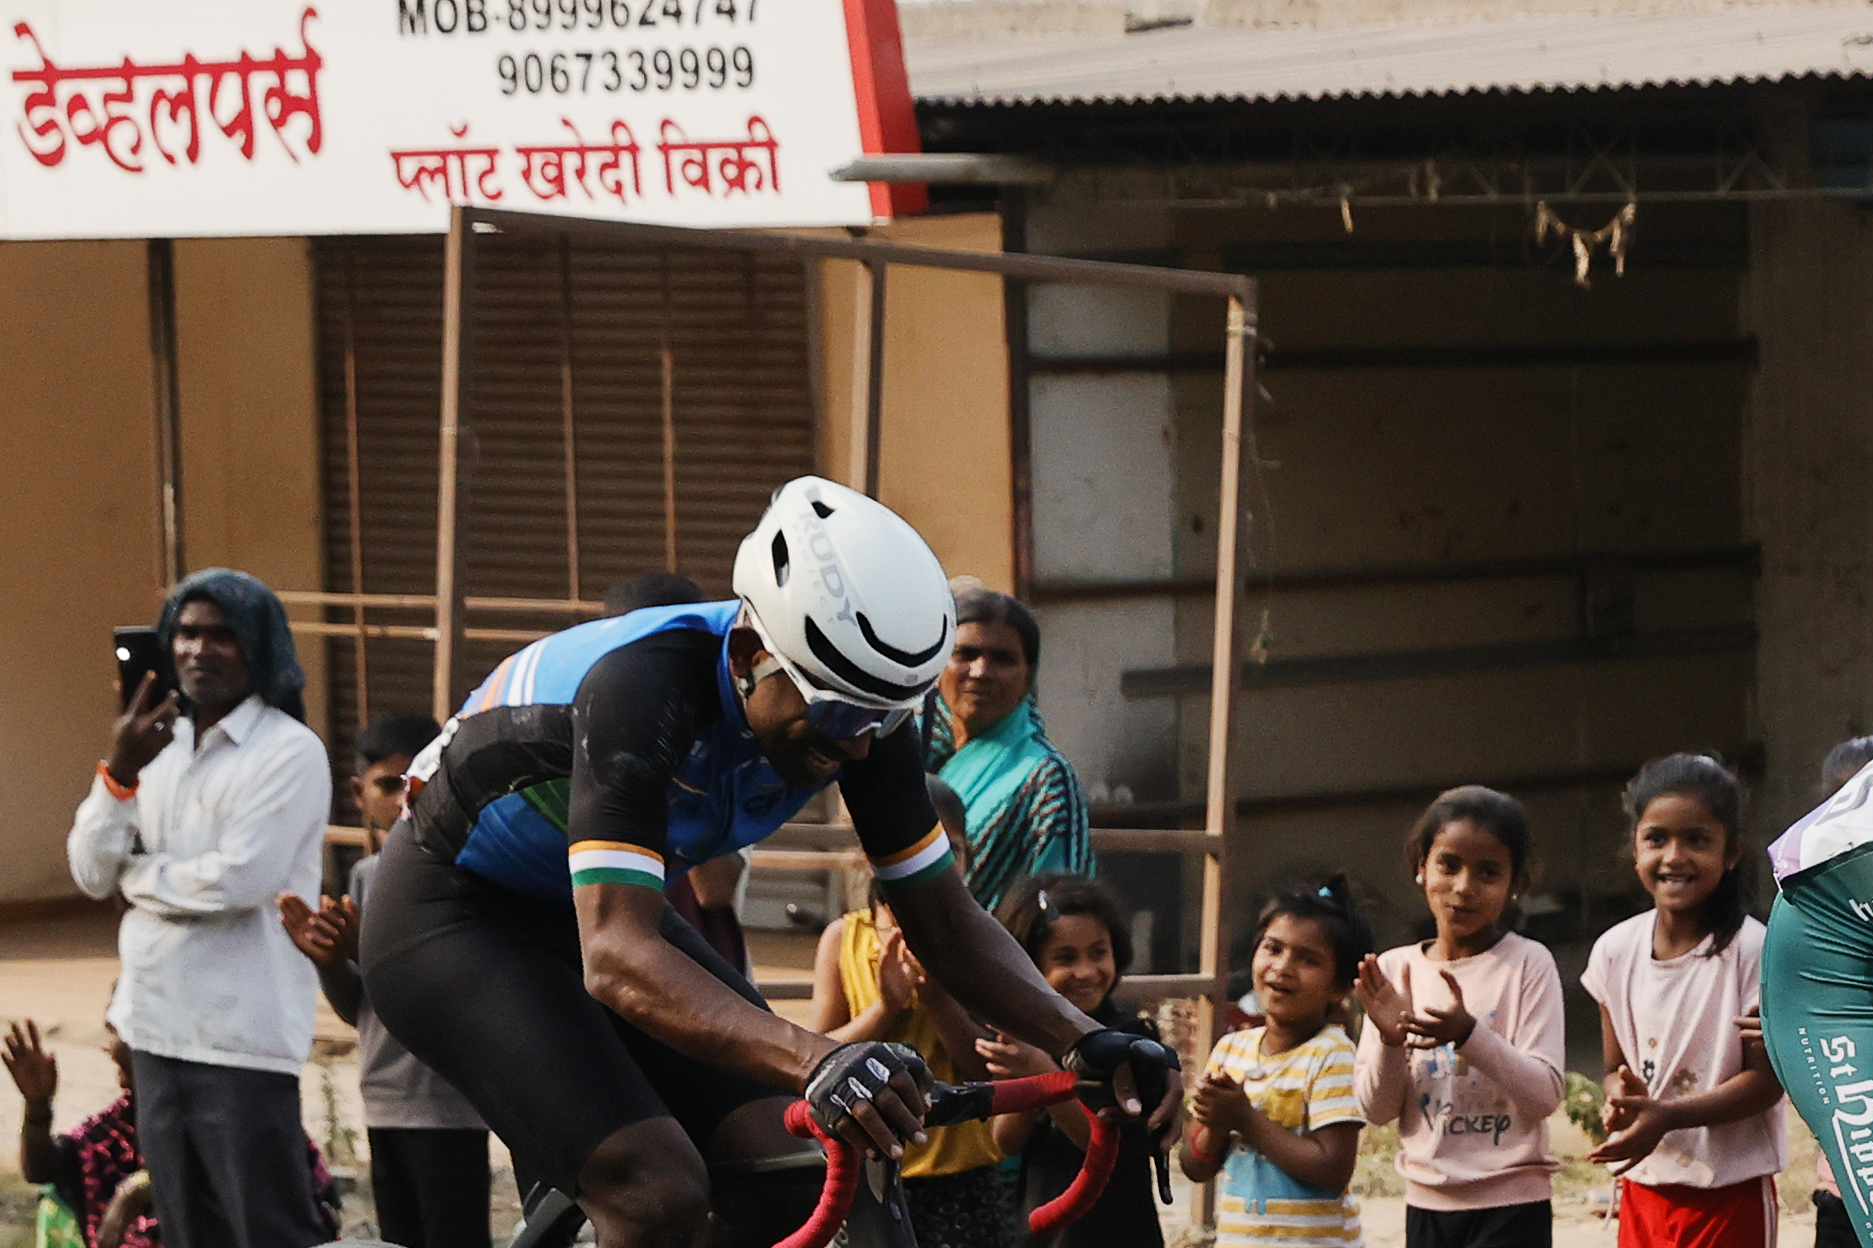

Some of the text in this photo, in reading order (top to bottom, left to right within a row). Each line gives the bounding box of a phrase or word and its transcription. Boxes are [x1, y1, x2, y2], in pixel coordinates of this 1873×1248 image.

[12, 6, 322, 173] डेव्हलपर्स
[498, 46, 755, 95] 9067339999
[391, 115, 780, 202] प्लॉट खरेदी विक्री
[799, 511, 857, 627] RUDY
[1798, 1027, 1830, 1105] NUTRITION
